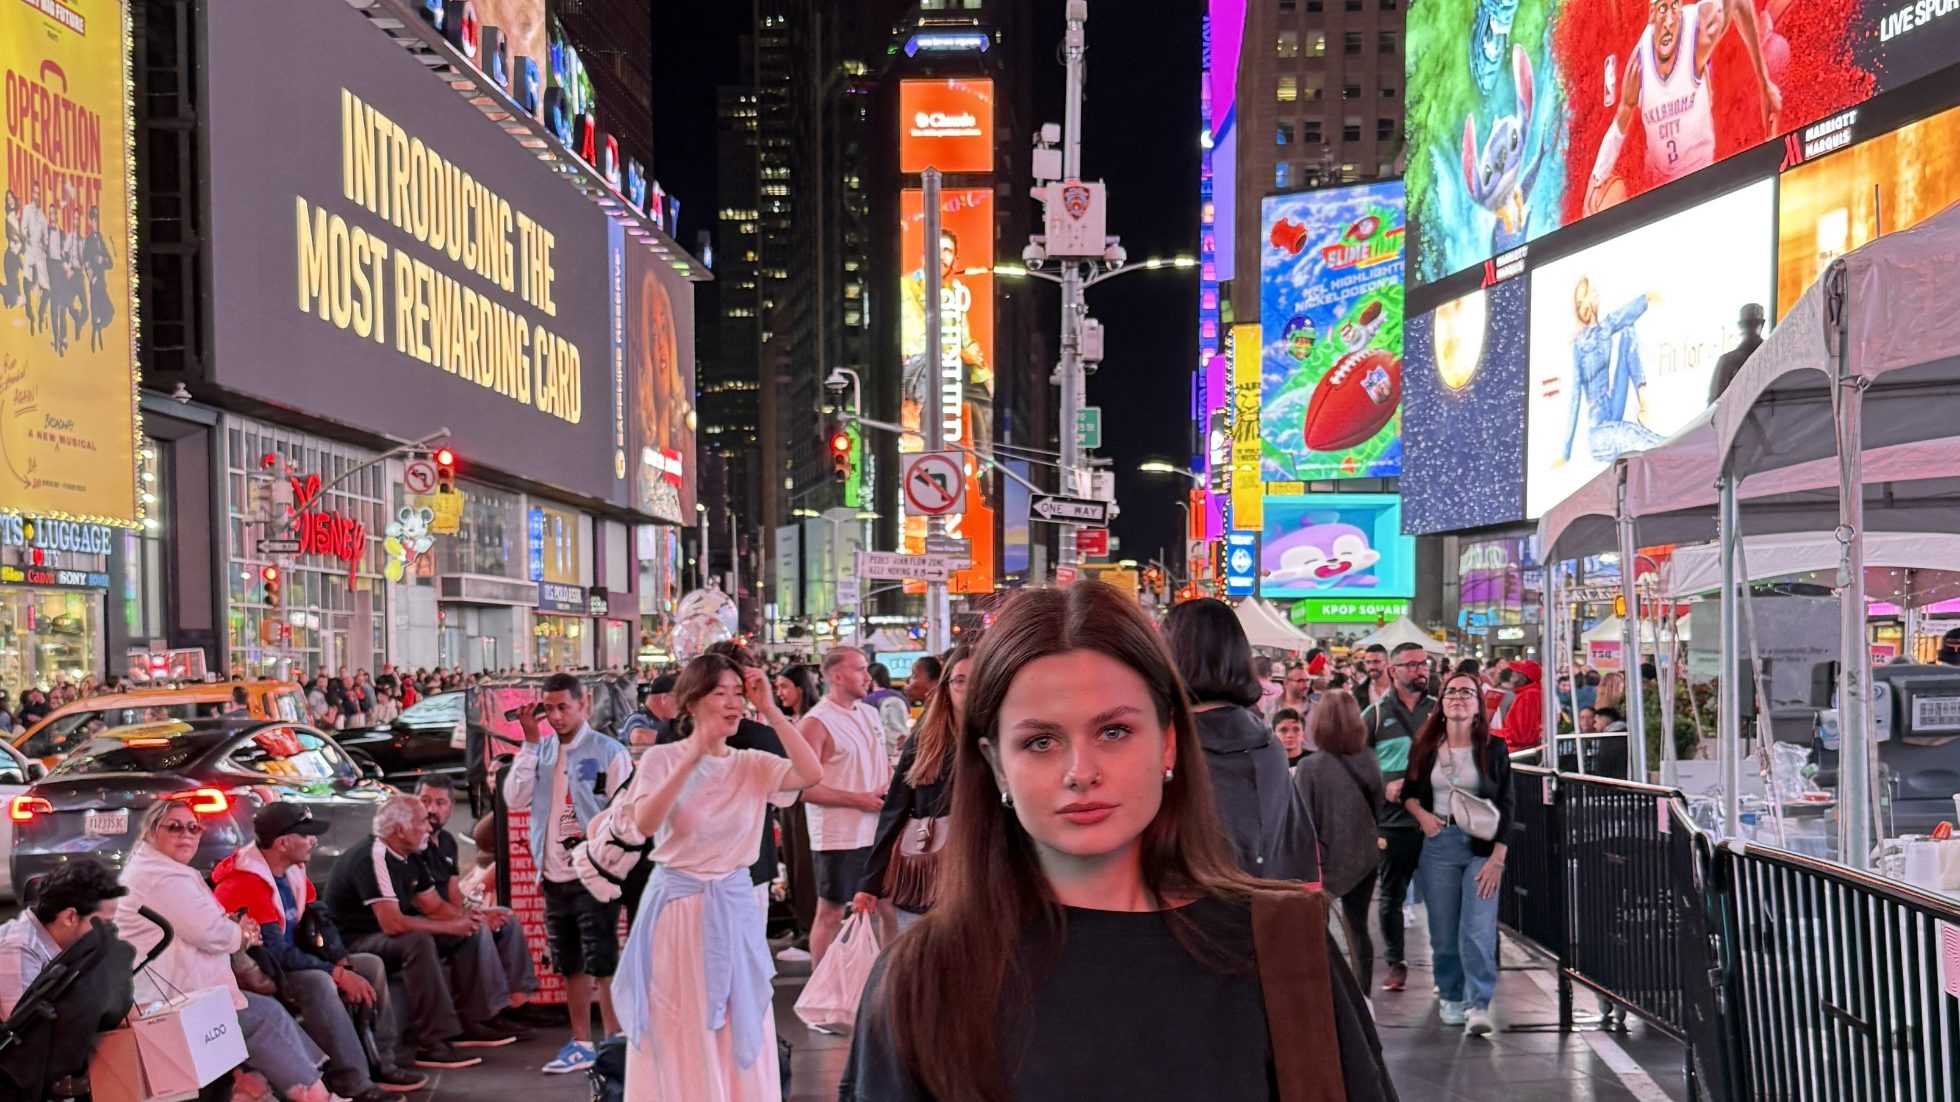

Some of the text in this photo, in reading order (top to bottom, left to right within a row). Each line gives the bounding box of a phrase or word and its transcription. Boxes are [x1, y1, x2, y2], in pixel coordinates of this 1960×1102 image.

[1880, 5, 1915, 42] LIVE
[5, 69, 101, 172] OPERATION
[1659, 118, 1680, 139] CITY
[1805, 109, 1858, 142] MARRIOTT
[1667, 140, 1679, 165] 3
[1805, 127, 1852, 158] MARQUIS
[341, 88, 556, 316] INTRODUCING THE
[296, 195, 388, 343] MOST
[394, 249, 531, 405] REWARDING
[534, 325, 581, 424] CARD
[29, 429, 97, 451] A NEW MUSICAL
[1041, 502, 1098, 516] ONE WAY
[34, 518, 112, 555] LUGGAGE
[28, 569, 55, 584] Canon
[60, 571, 87, 585] SONY
[1322, 604, 1408, 616] KPOP SQUARE
[205, 1024, 227, 1044] ALDO
